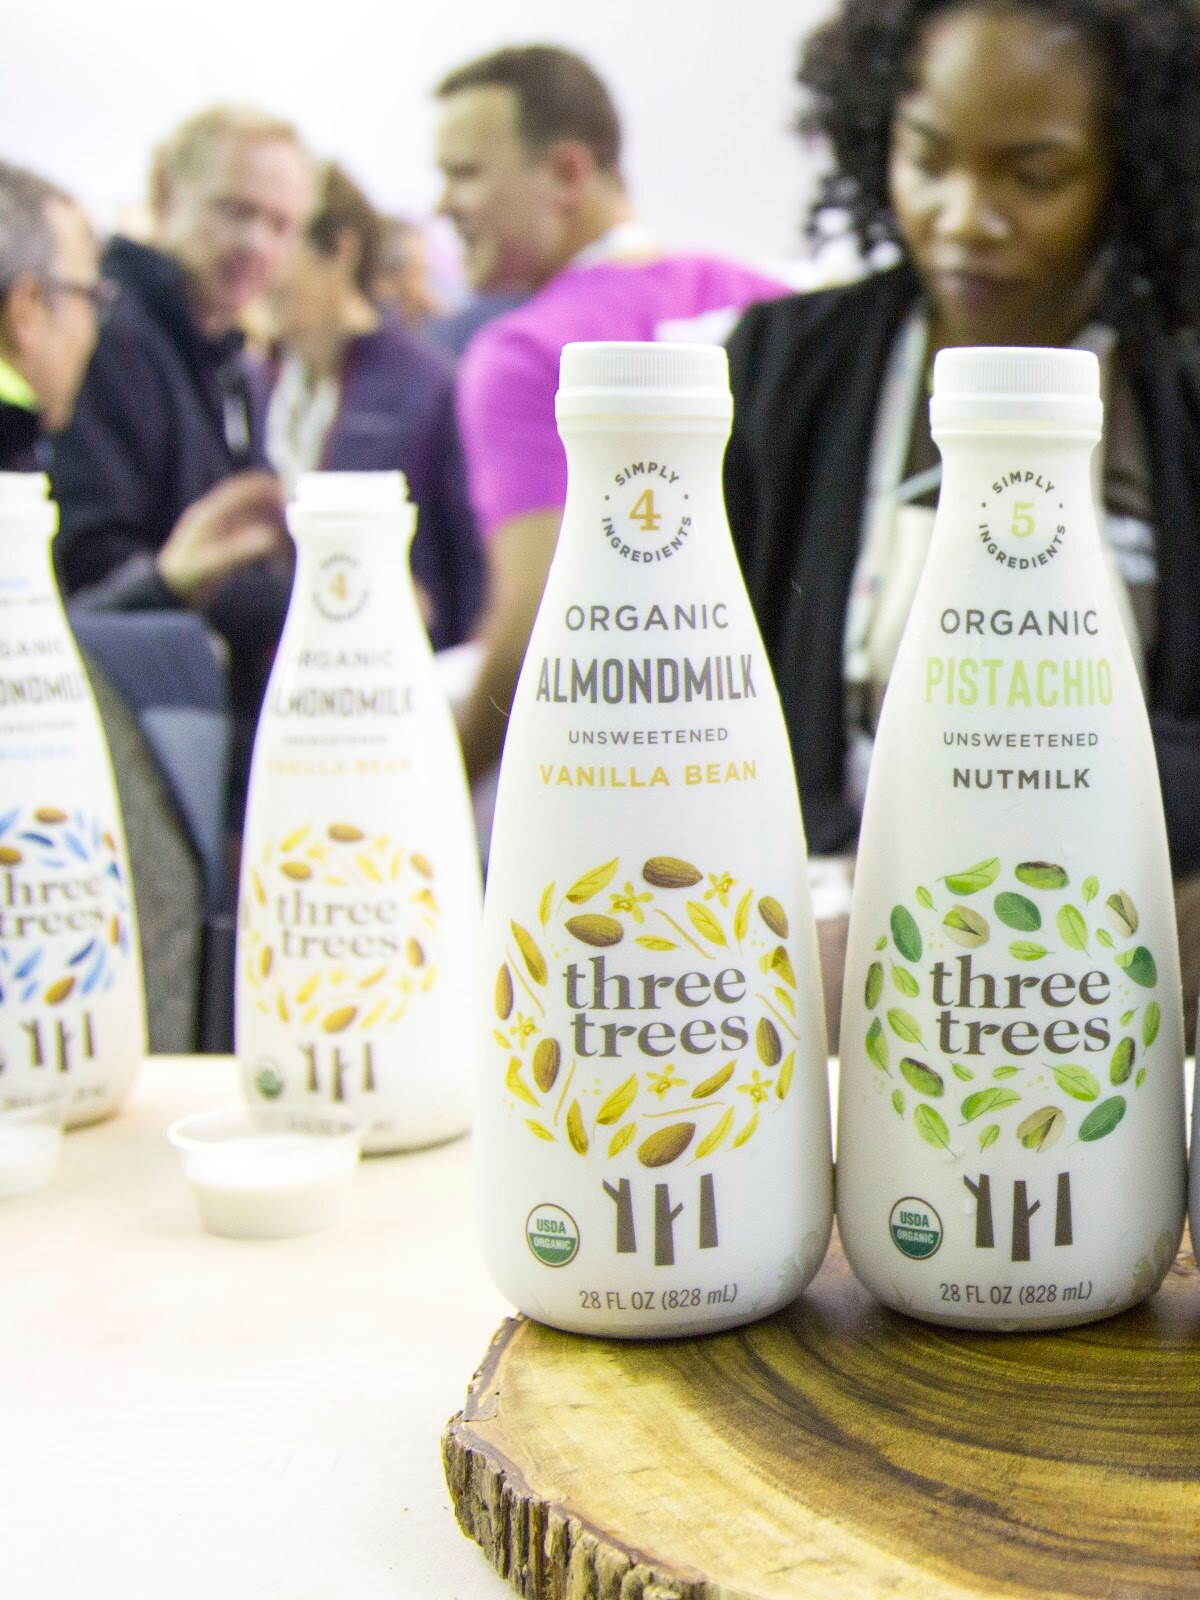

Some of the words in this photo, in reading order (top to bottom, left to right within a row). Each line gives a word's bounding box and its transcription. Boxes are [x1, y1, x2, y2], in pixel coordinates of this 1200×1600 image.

[614, 461, 680, 486] SIMPLY
[992, 471, 1055, 494] SIMPLY
[629, 489, 661, 531] 4
[1010, 502, 1035, 538] 5
[602, 516, 692, 563] INGREDIENTS
[979, 524, 1066, 570] INGREDIENTS
[565, 603, 729, 631] ORGANIC
[940, 609, 1099, 636] ORGANIC
[536, 653, 757, 704] ALMONDMILK
[924, 656, 1113, 707] PISTACHIO
[569, 727, 729, 745] UNSWEETENED
[943, 731, 1099, 748] UNSWEETENED
[540, 765, 670, 787] VANILLA
[685, 760, 757, 784] BEAN
[953, 768, 1090, 790] NUTMILK
[4, 873, 101, 908] hree
[277, 889, 398, 926] three
[281, 930, 398, 960] trees
[563, 955, 747, 1010] three
[930, 955, 1111, 1009] three
[570, 1012, 749, 1058] trees
[935, 1010, 1111, 1056] trees
[536, 1217, 566, 1235] USDA
[900, 1211, 930, 1227] USDA
[533, 1235, 572, 1251] ORGANIC
[897, 1229, 934, 1245] ORGANIC
[579, 1290, 600, 1309] 28
[607, 1291, 627, 1310] FL
[631, 1290, 655, 1310] OZ
[662, 1287, 701, 1311] (828
[706, 1283, 738, 1305] mL)
[940, 1283, 960, 1301] 28
[967, 1285, 985, 1303] FL
[990, 1285, 1012, 1304] OZ
[1019, 1284, 1057, 1305] (828
[1063, 1281, 1092, 1301] mL)
